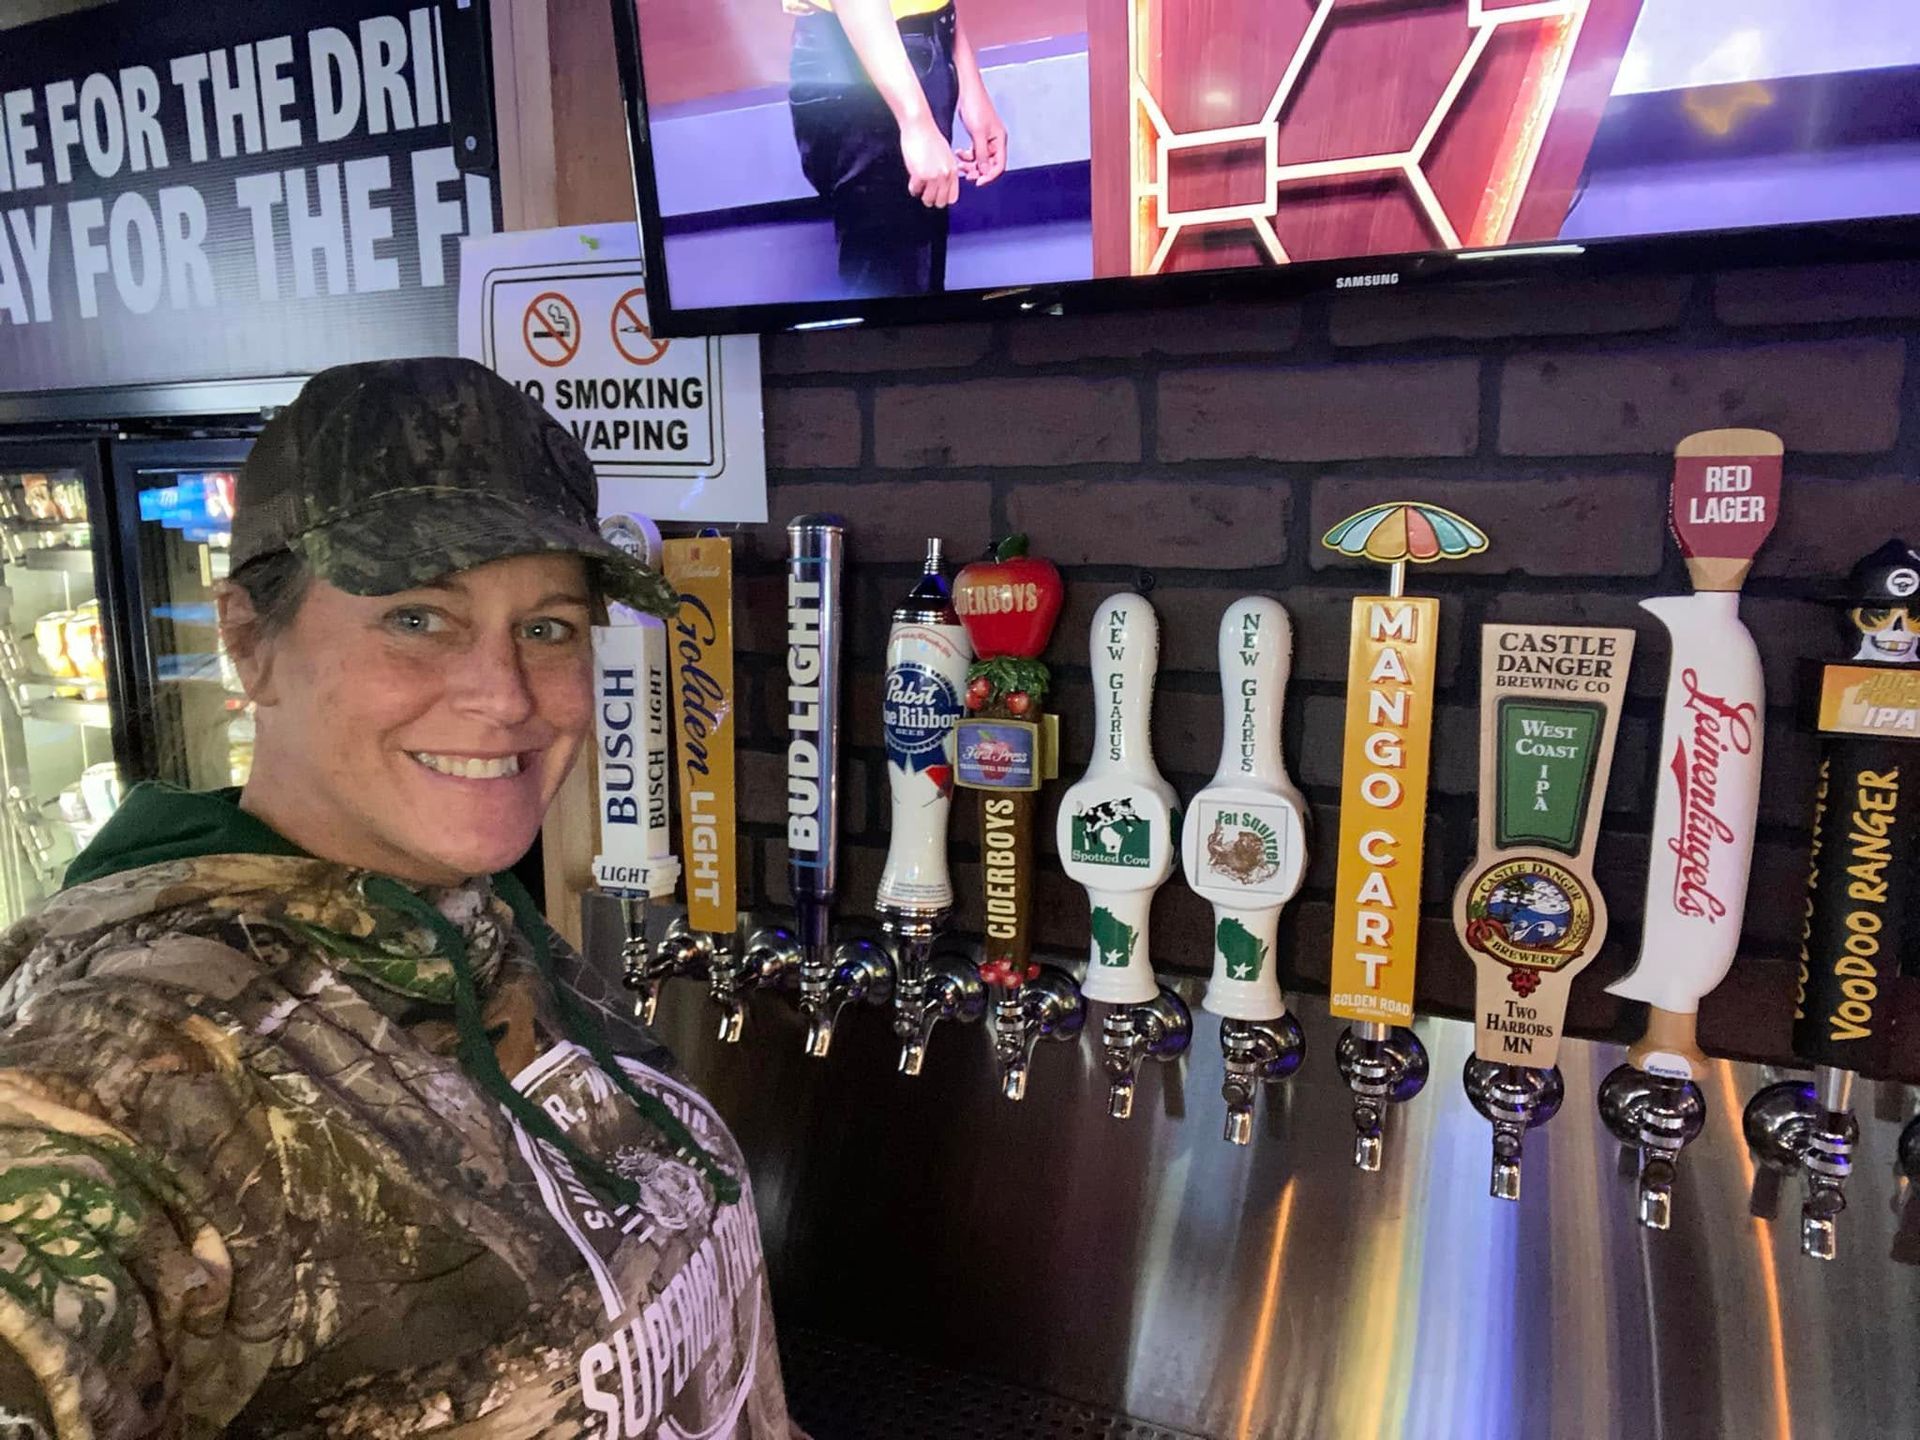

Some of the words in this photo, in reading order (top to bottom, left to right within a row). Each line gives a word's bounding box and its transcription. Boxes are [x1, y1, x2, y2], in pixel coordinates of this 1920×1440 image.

[0, 85, 44, 191] E
[45, 65, 169, 184] FOR
[170, 35, 302, 162] THE
[68, 185, 216, 318] FOR
[235, 155, 401, 301] THE
[1336, 273, 1399, 288] SAMSUNG
[555, 377, 704, 410] SMOKING
[570, 419, 689, 451] VAPING
[1705, 465, 1752, 493] RED
[1689, 495, 1766, 524] LAGER
[787, 573, 821, 731] LIGHT
[1107, 610, 1128, 661] NEW
[1239, 612, 1261, 666] NEW
[1499, 632, 1616, 656] CASTLE
[674, 592, 725, 787] Golden
[886, 673, 940, 705] Pabst
[1496, 654, 1612, 678] DANGER
[1496, 675, 1578, 691] BREWING
[1584, 680, 1610, 693] CO
[650, 667, 663, 736] LIGHT
[1108, 672, 1124, 762] GLARUS
[1241, 678, 1258, 773] GLARUS
[1360, 604, 1417, 809] MANGO
[1862, 706, 1916, 730] IPA
[603, 668, 639, 826] BUSCH
[649, 750, 666, 830] BUSCH
[787, 740, 820, 852] BUD
[690, 790, 721, 909] LIGHT
[1071, 848, 1120, 864] Spotted
[1123, 853, 1150, 866] Cow
[1215, 810, 1238, 826] Fat
[1241, 811, 1280, 866] Squirrel
[1846, 766, 1899, 903] RANGER
[600, 865, 650, 884] LIGHT
[987, 798, 1017, 940] CIDERBOYS
[1355, 830, 1399, 988] CART
[1491, 941, 1559, 965] BREWERY
[1830, 909, 1883, 1041] VOODOO
[1332, 993, 1377, 1008] GOLDEN
[1380, 997, 1410, 1017] ROAD
[1502, 1037, 1534, 1055] MN
